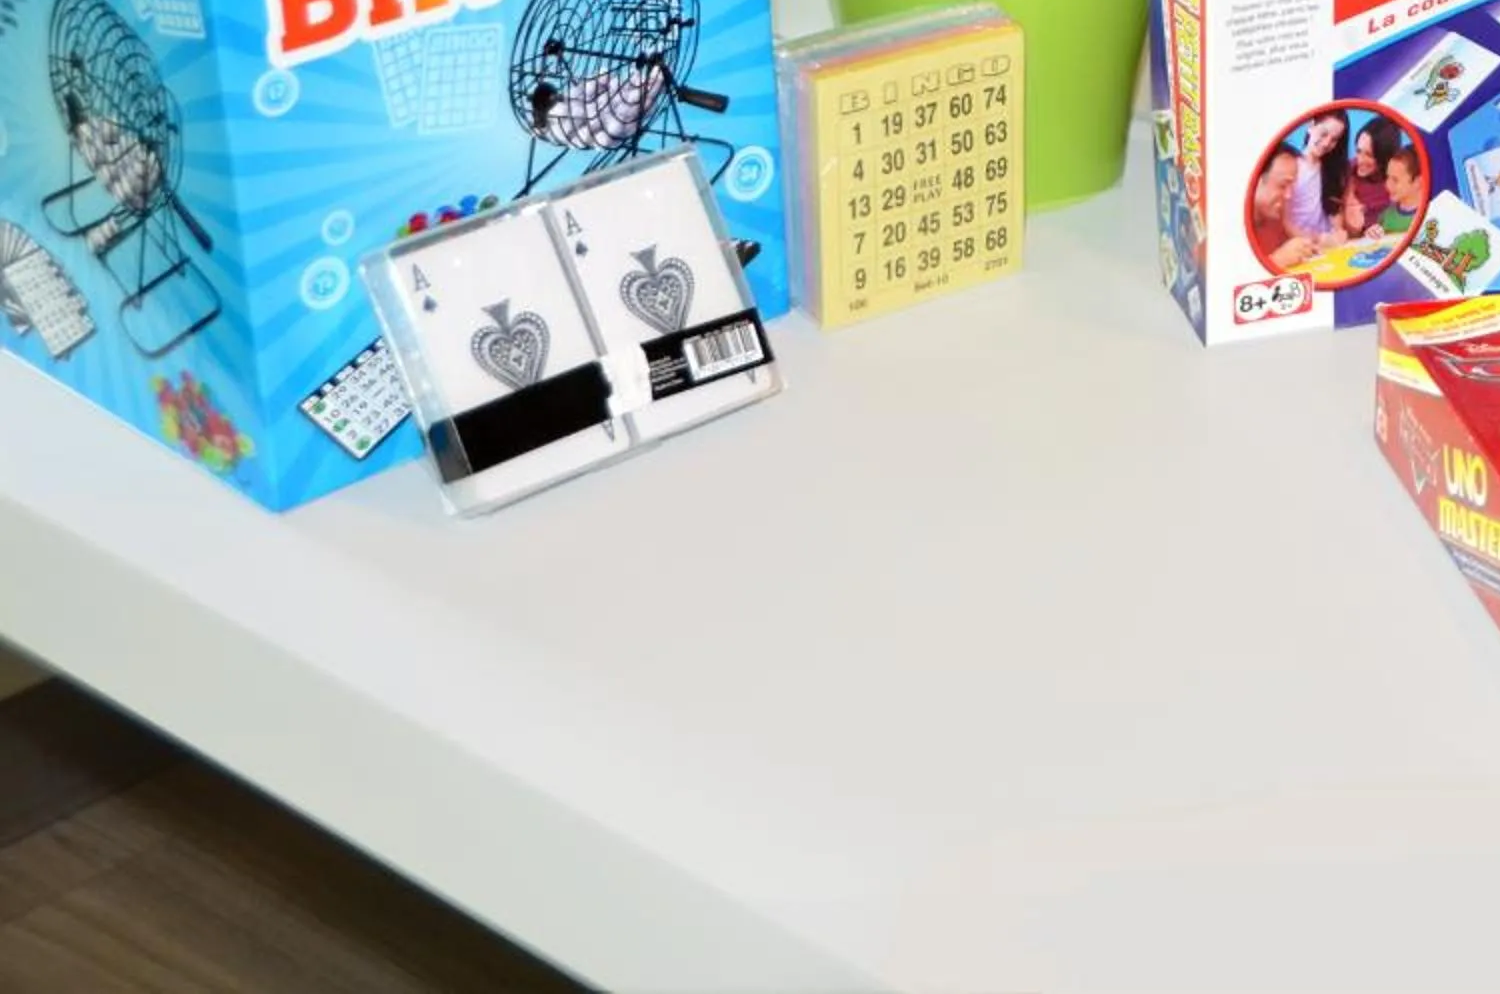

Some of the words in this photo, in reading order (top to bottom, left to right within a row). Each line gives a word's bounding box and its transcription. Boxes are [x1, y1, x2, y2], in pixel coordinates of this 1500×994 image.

[1366, 12, 1396, 35] La
[853, 122, 862, 145] 1
[881, 111, 903, 137] 19
[915, 102, 937, 128] 37
[949, 93, 972, 119] 60
[983, 84, 1007, 110] 74
[853, 159, 864, 182] 4
[881, 148, 905, 175] 30
[915, 139, 938, 165] 31
[950, 129, 973, 155] 50
[985, 120, 1008, 147] 63
[848, 194, 871, 220] 13
[882, 185, 905, 211] 29
[951, 165, 975, 192] 48
[985, 156, 1008, 182] 69
[912, 187, 943, 204] PLAY
[913, 174, 942, 191] FREE
[564, 209, 583, 238] A
[854, 232, 866, 256] 7
[882, 221, 906, 247] 20
[917, 211, 941, 237] 45
[952, 201, 975, 227] 53
[985, 191, 1008, 217] 75
[412, 262, 432, 293] A
[854, 267, 867, 291] 9
[884, 255, 906, 282] 16
[918, 246, 942, 273] 39
[952, 236, 976, 262] 58
[985, 226, 1008, 253] 68
[1239, 294, 1267, 313] 8+
[1442, 442, 1488, 507] UNO
